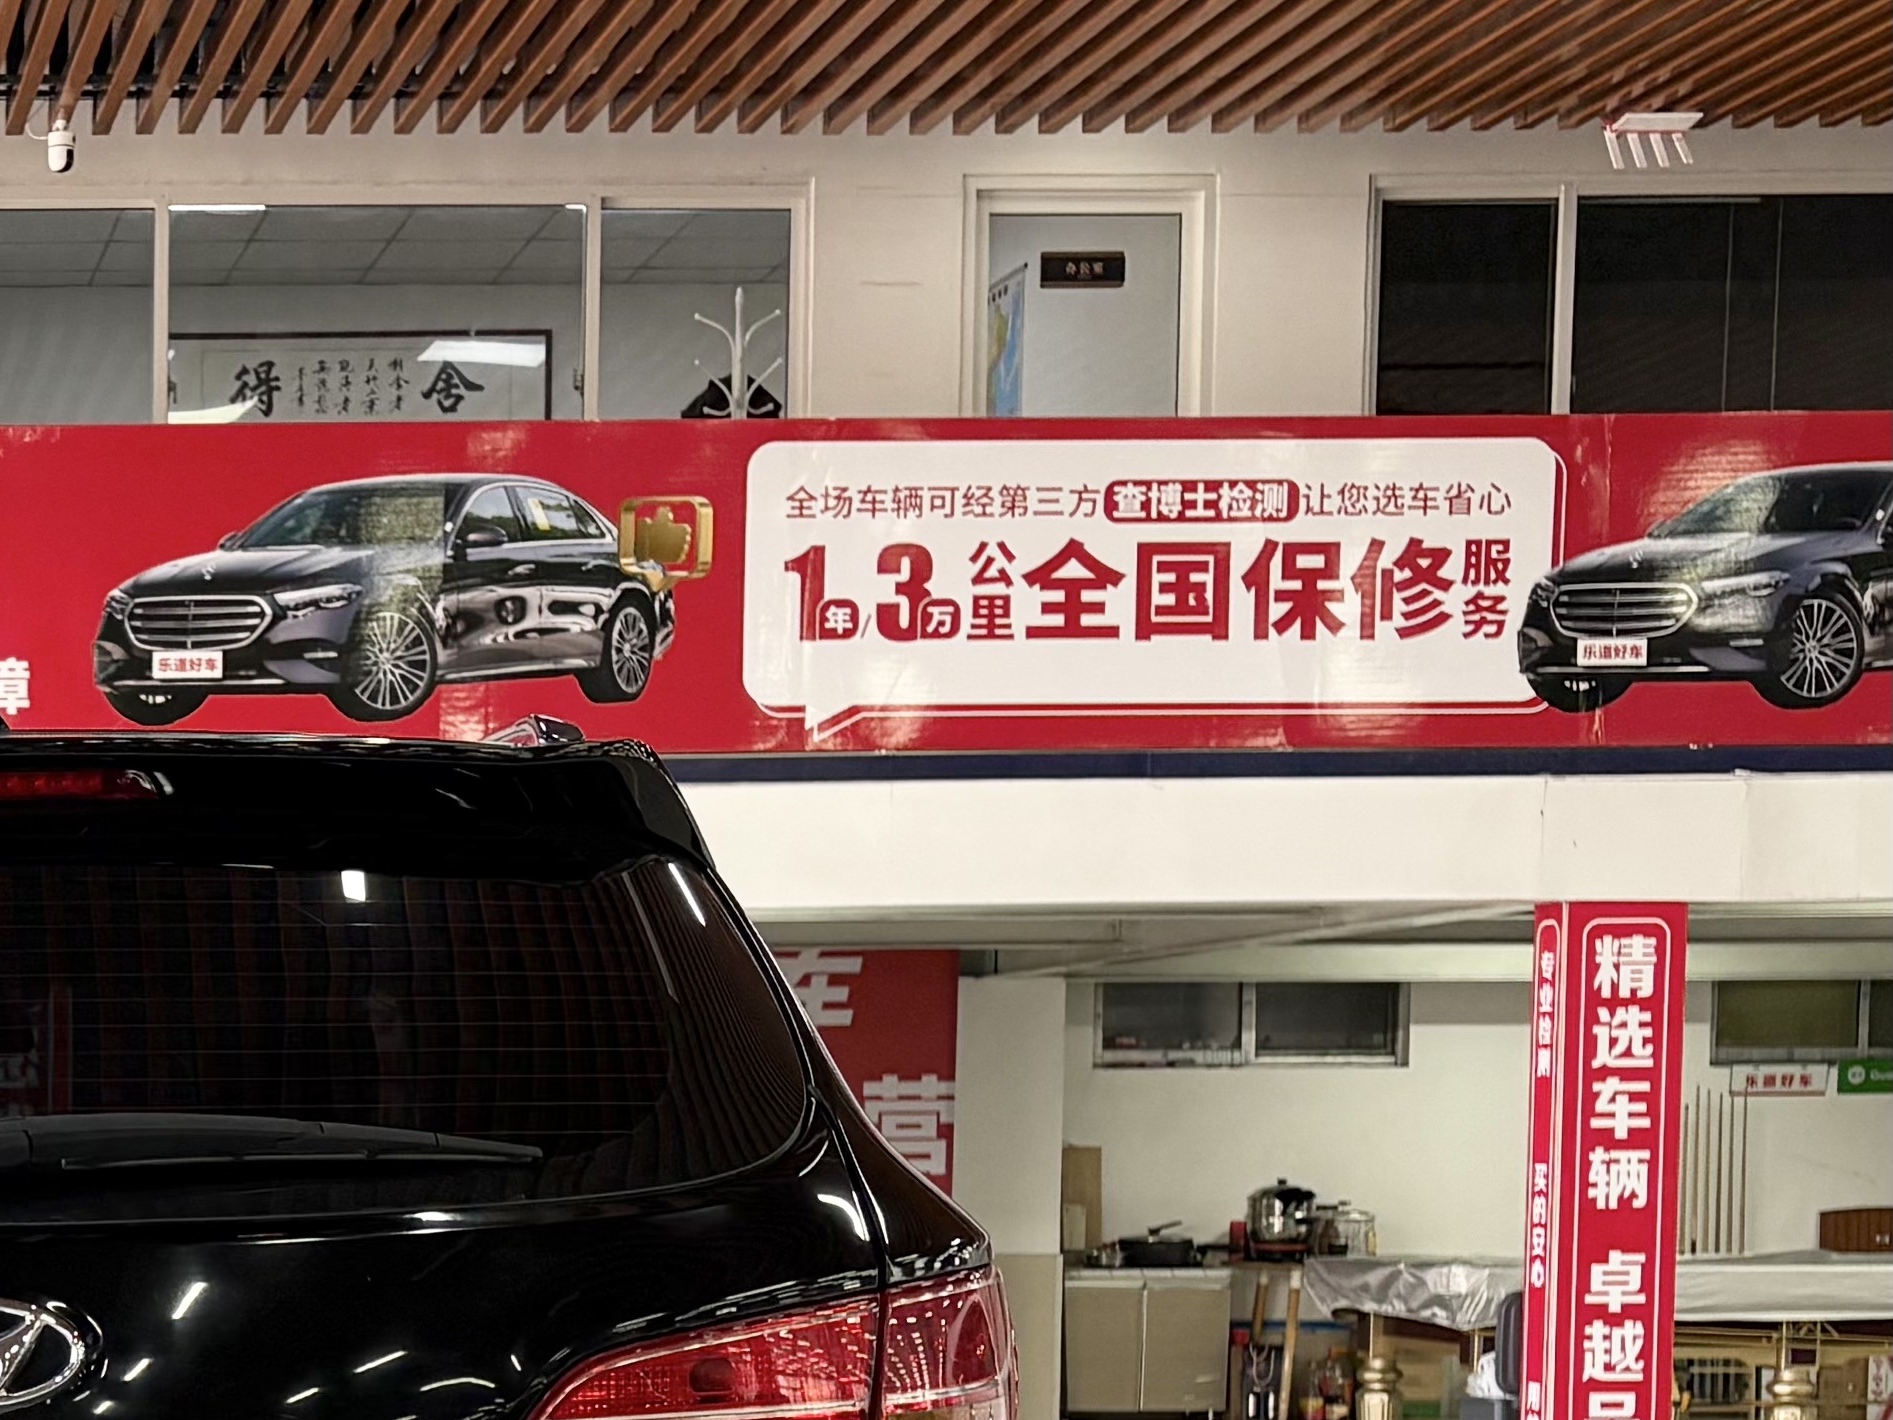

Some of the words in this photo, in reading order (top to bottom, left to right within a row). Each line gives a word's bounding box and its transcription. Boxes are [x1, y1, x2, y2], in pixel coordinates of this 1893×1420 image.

[1583, 643, 1643, 660] 乐道好车
[158, 657, 219, 673] 乐道好车
[1588, 934, 1657, 1210] 精选车辆
